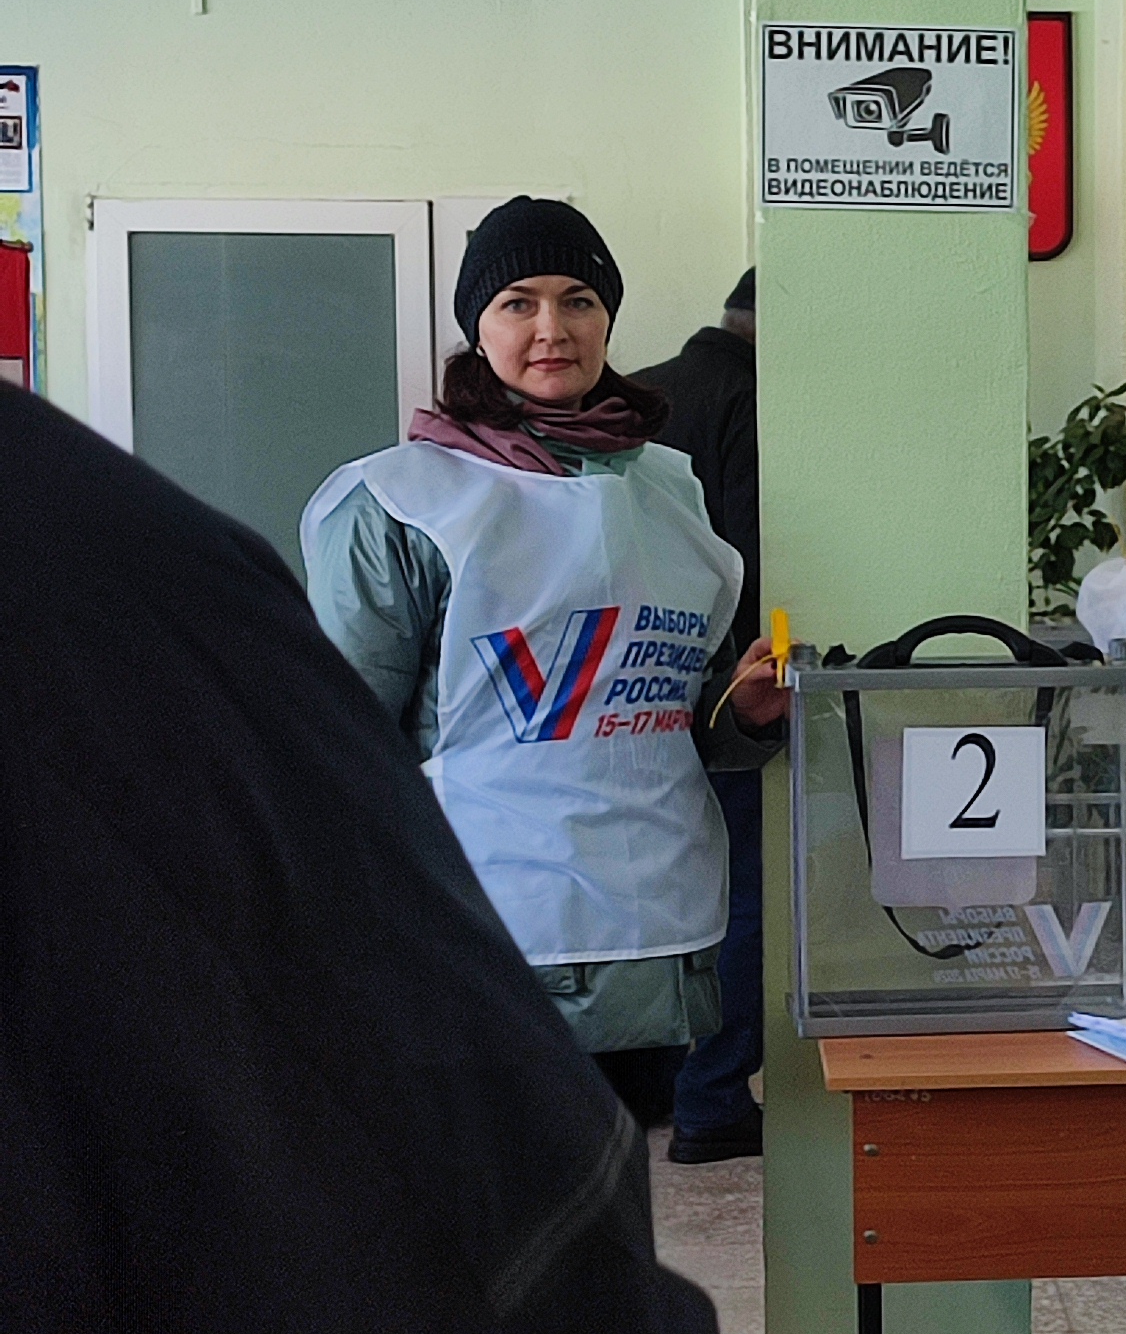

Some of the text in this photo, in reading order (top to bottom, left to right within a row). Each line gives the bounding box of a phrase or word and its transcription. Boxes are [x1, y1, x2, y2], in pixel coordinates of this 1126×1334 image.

[767, 29, 1010, 65] ВНИМАНИЕ!
[767, 158, 1009, 179] В ПОМЕЩЕНИИ ВЕДЁТСЯ
[767, 178, 1009, 201] ВИДЕОНАБЛЮДЕНИЕ
[634, 604, 711, 638] ВЫБОРЫ
[619, 640, 705, 675] ПРЕЗИДЕ
[949, 733, 1000, 829] 2
